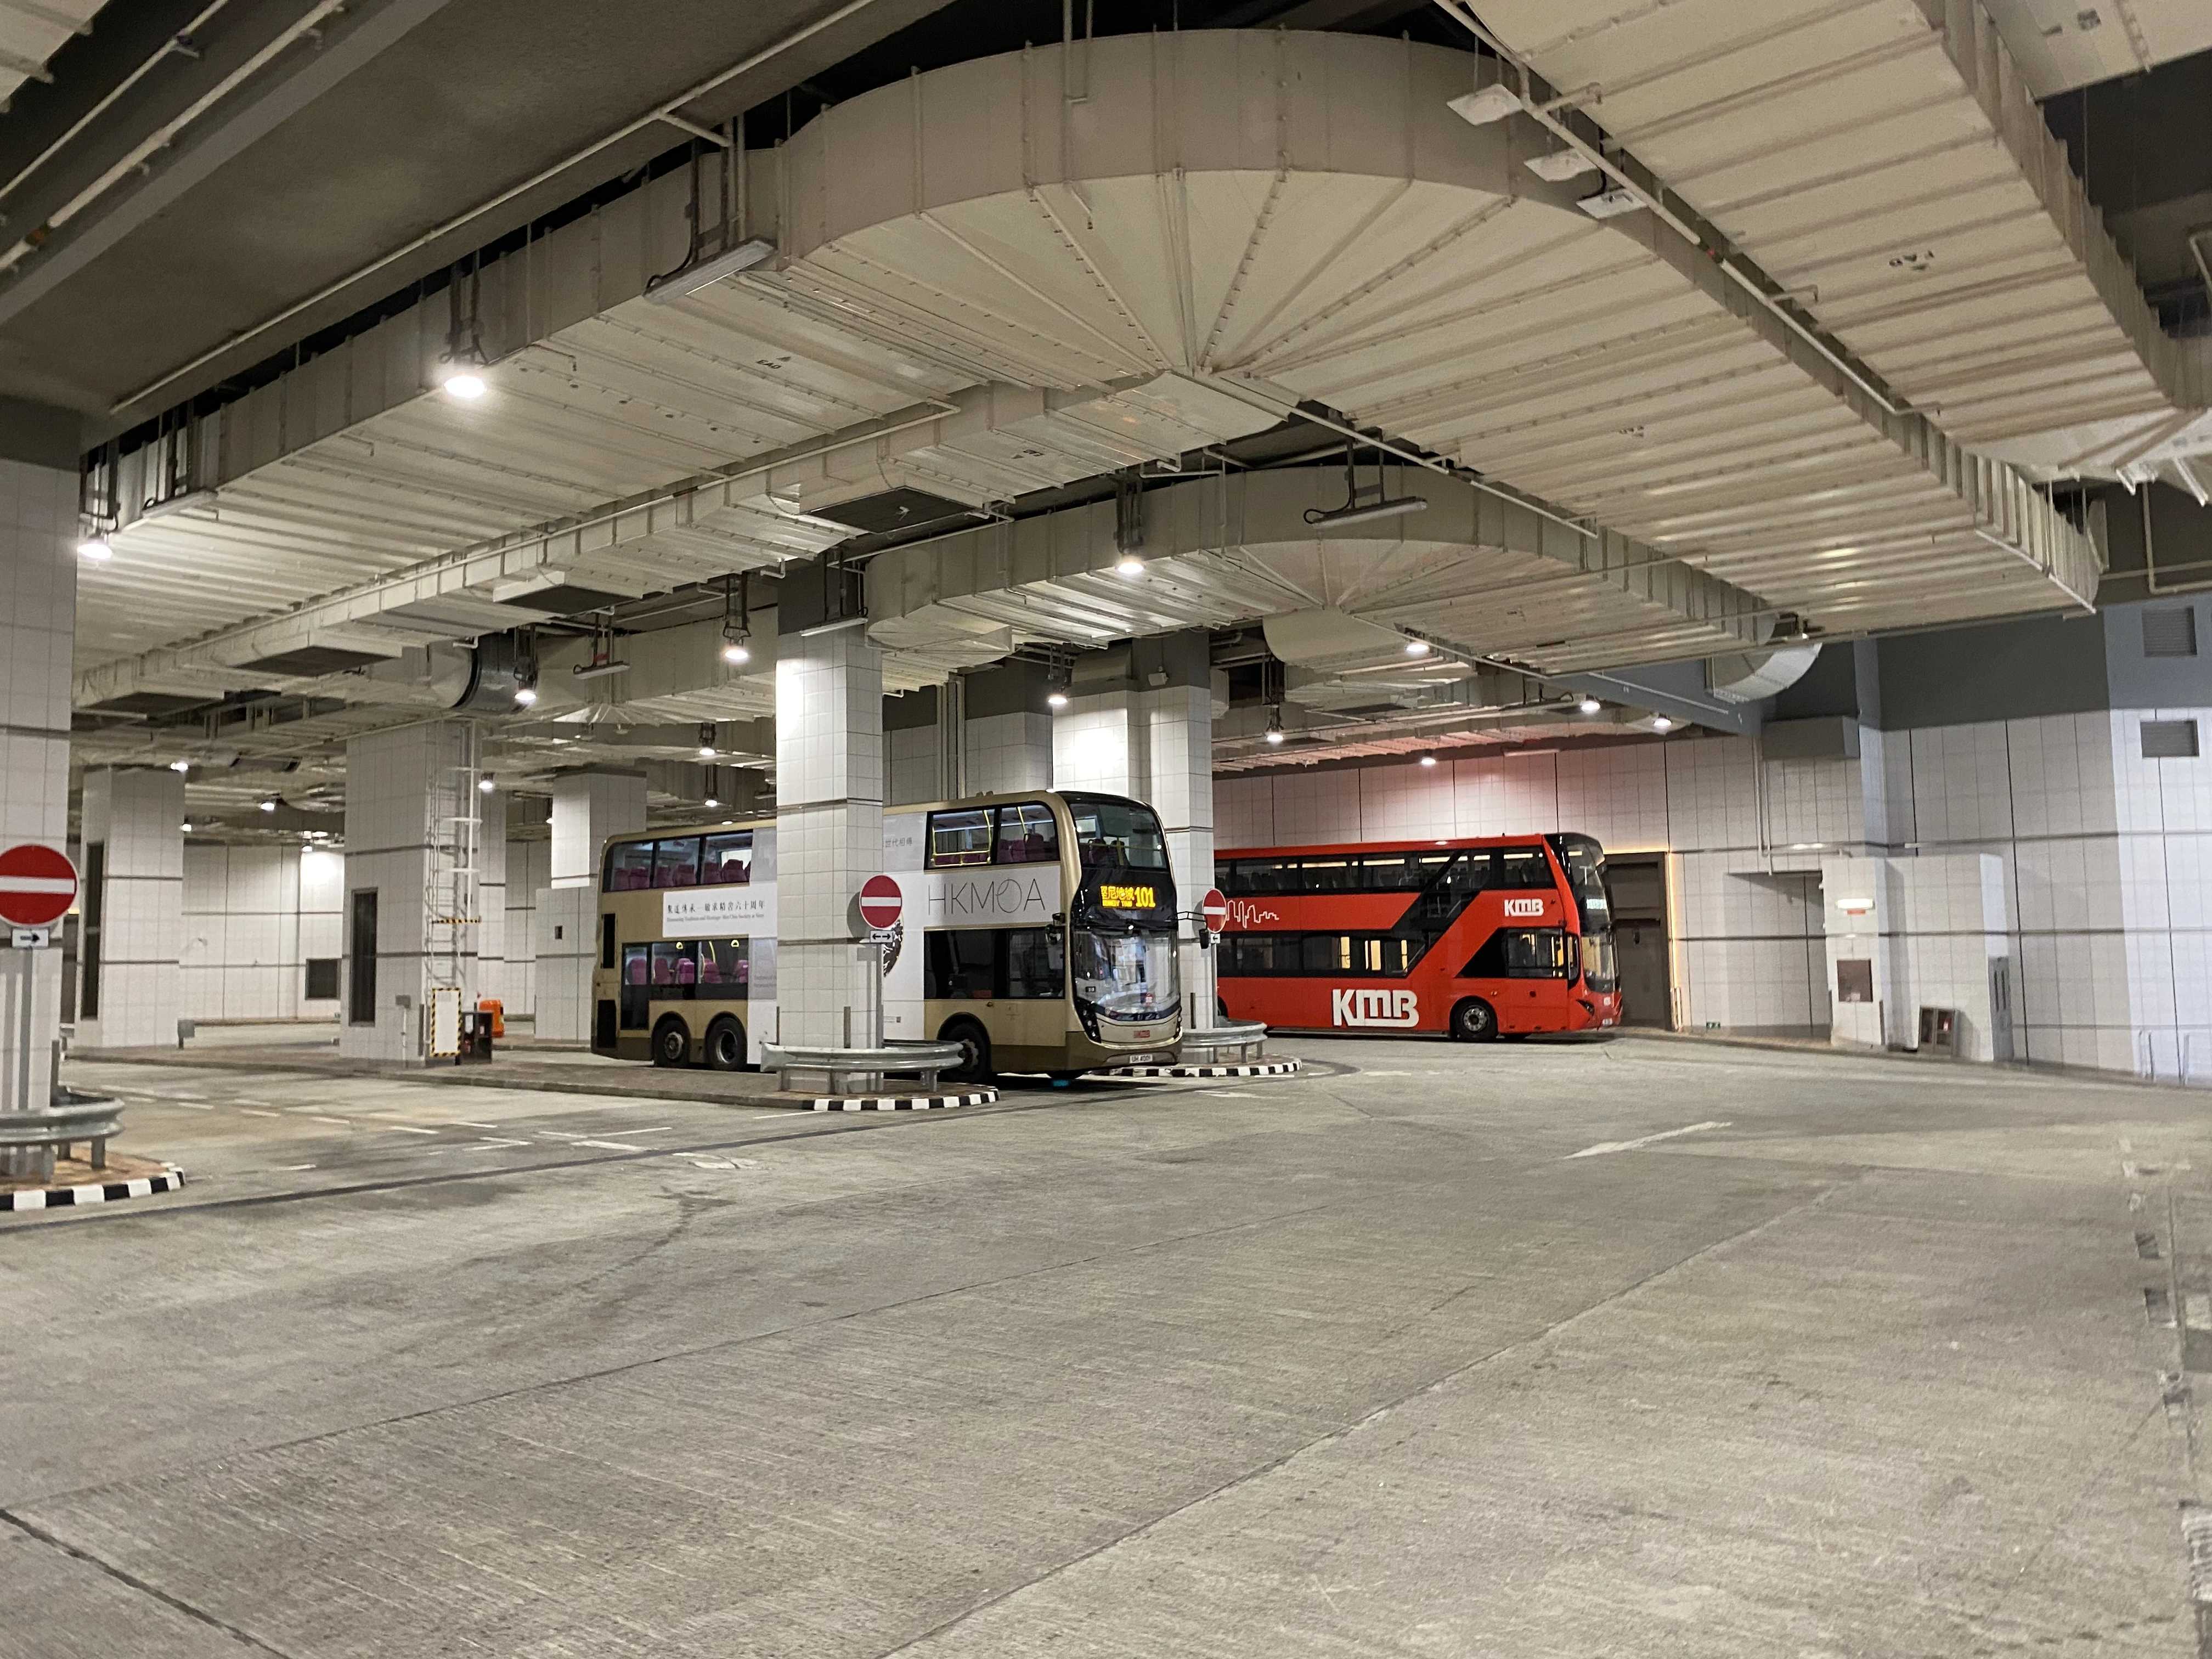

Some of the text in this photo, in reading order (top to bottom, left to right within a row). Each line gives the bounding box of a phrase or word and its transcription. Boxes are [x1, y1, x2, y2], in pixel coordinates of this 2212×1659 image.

[928, 878, 1046, 916] HKMOA
[1135, 887, 1156, 907] 101
[1504, 898, 1544, 917] KMB
[1332, 989, 1420, 1028] KMB
